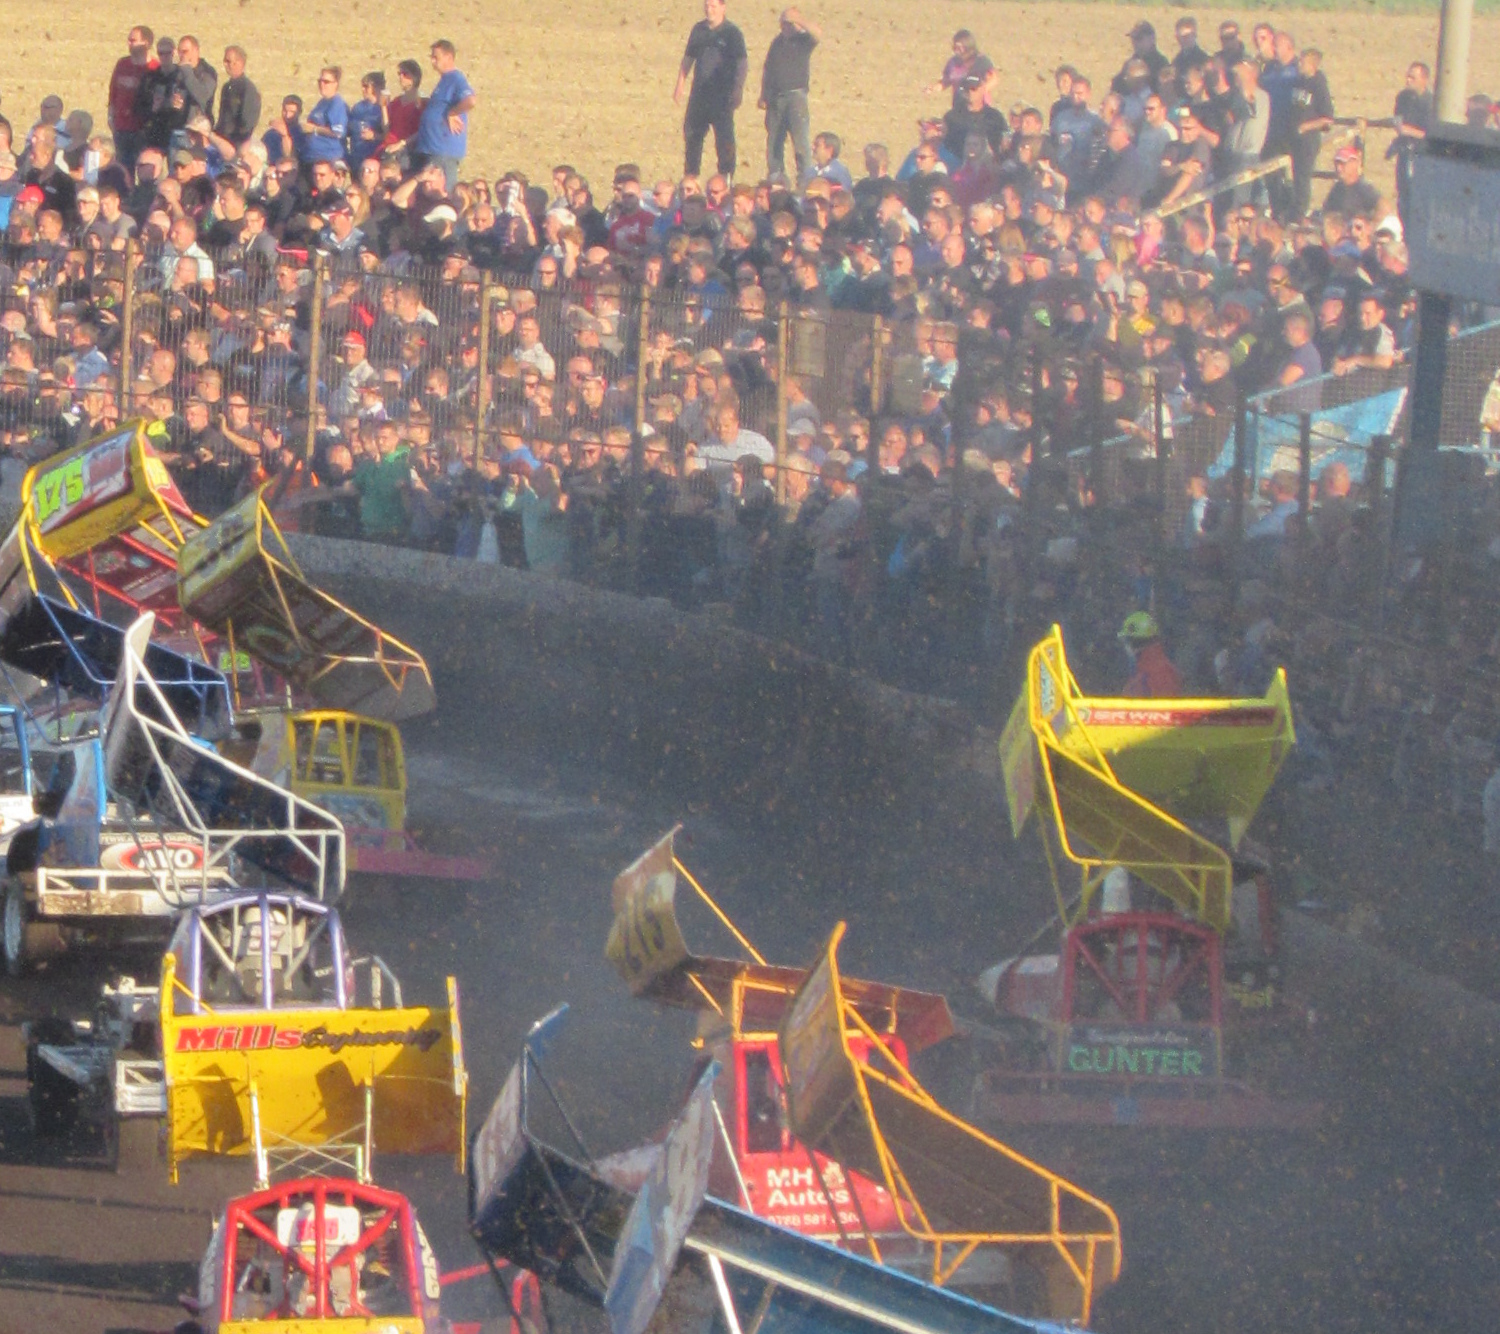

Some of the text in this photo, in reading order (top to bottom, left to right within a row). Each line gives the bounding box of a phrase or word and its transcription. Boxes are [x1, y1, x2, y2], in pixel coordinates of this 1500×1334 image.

[34, 455, 85, 525] 175
[175, 1024, 443, 1055] Mills Engineering
[1068, 1044, 1203, 1075] GUNTER
[767, 1188, 850, 1208] Autos
